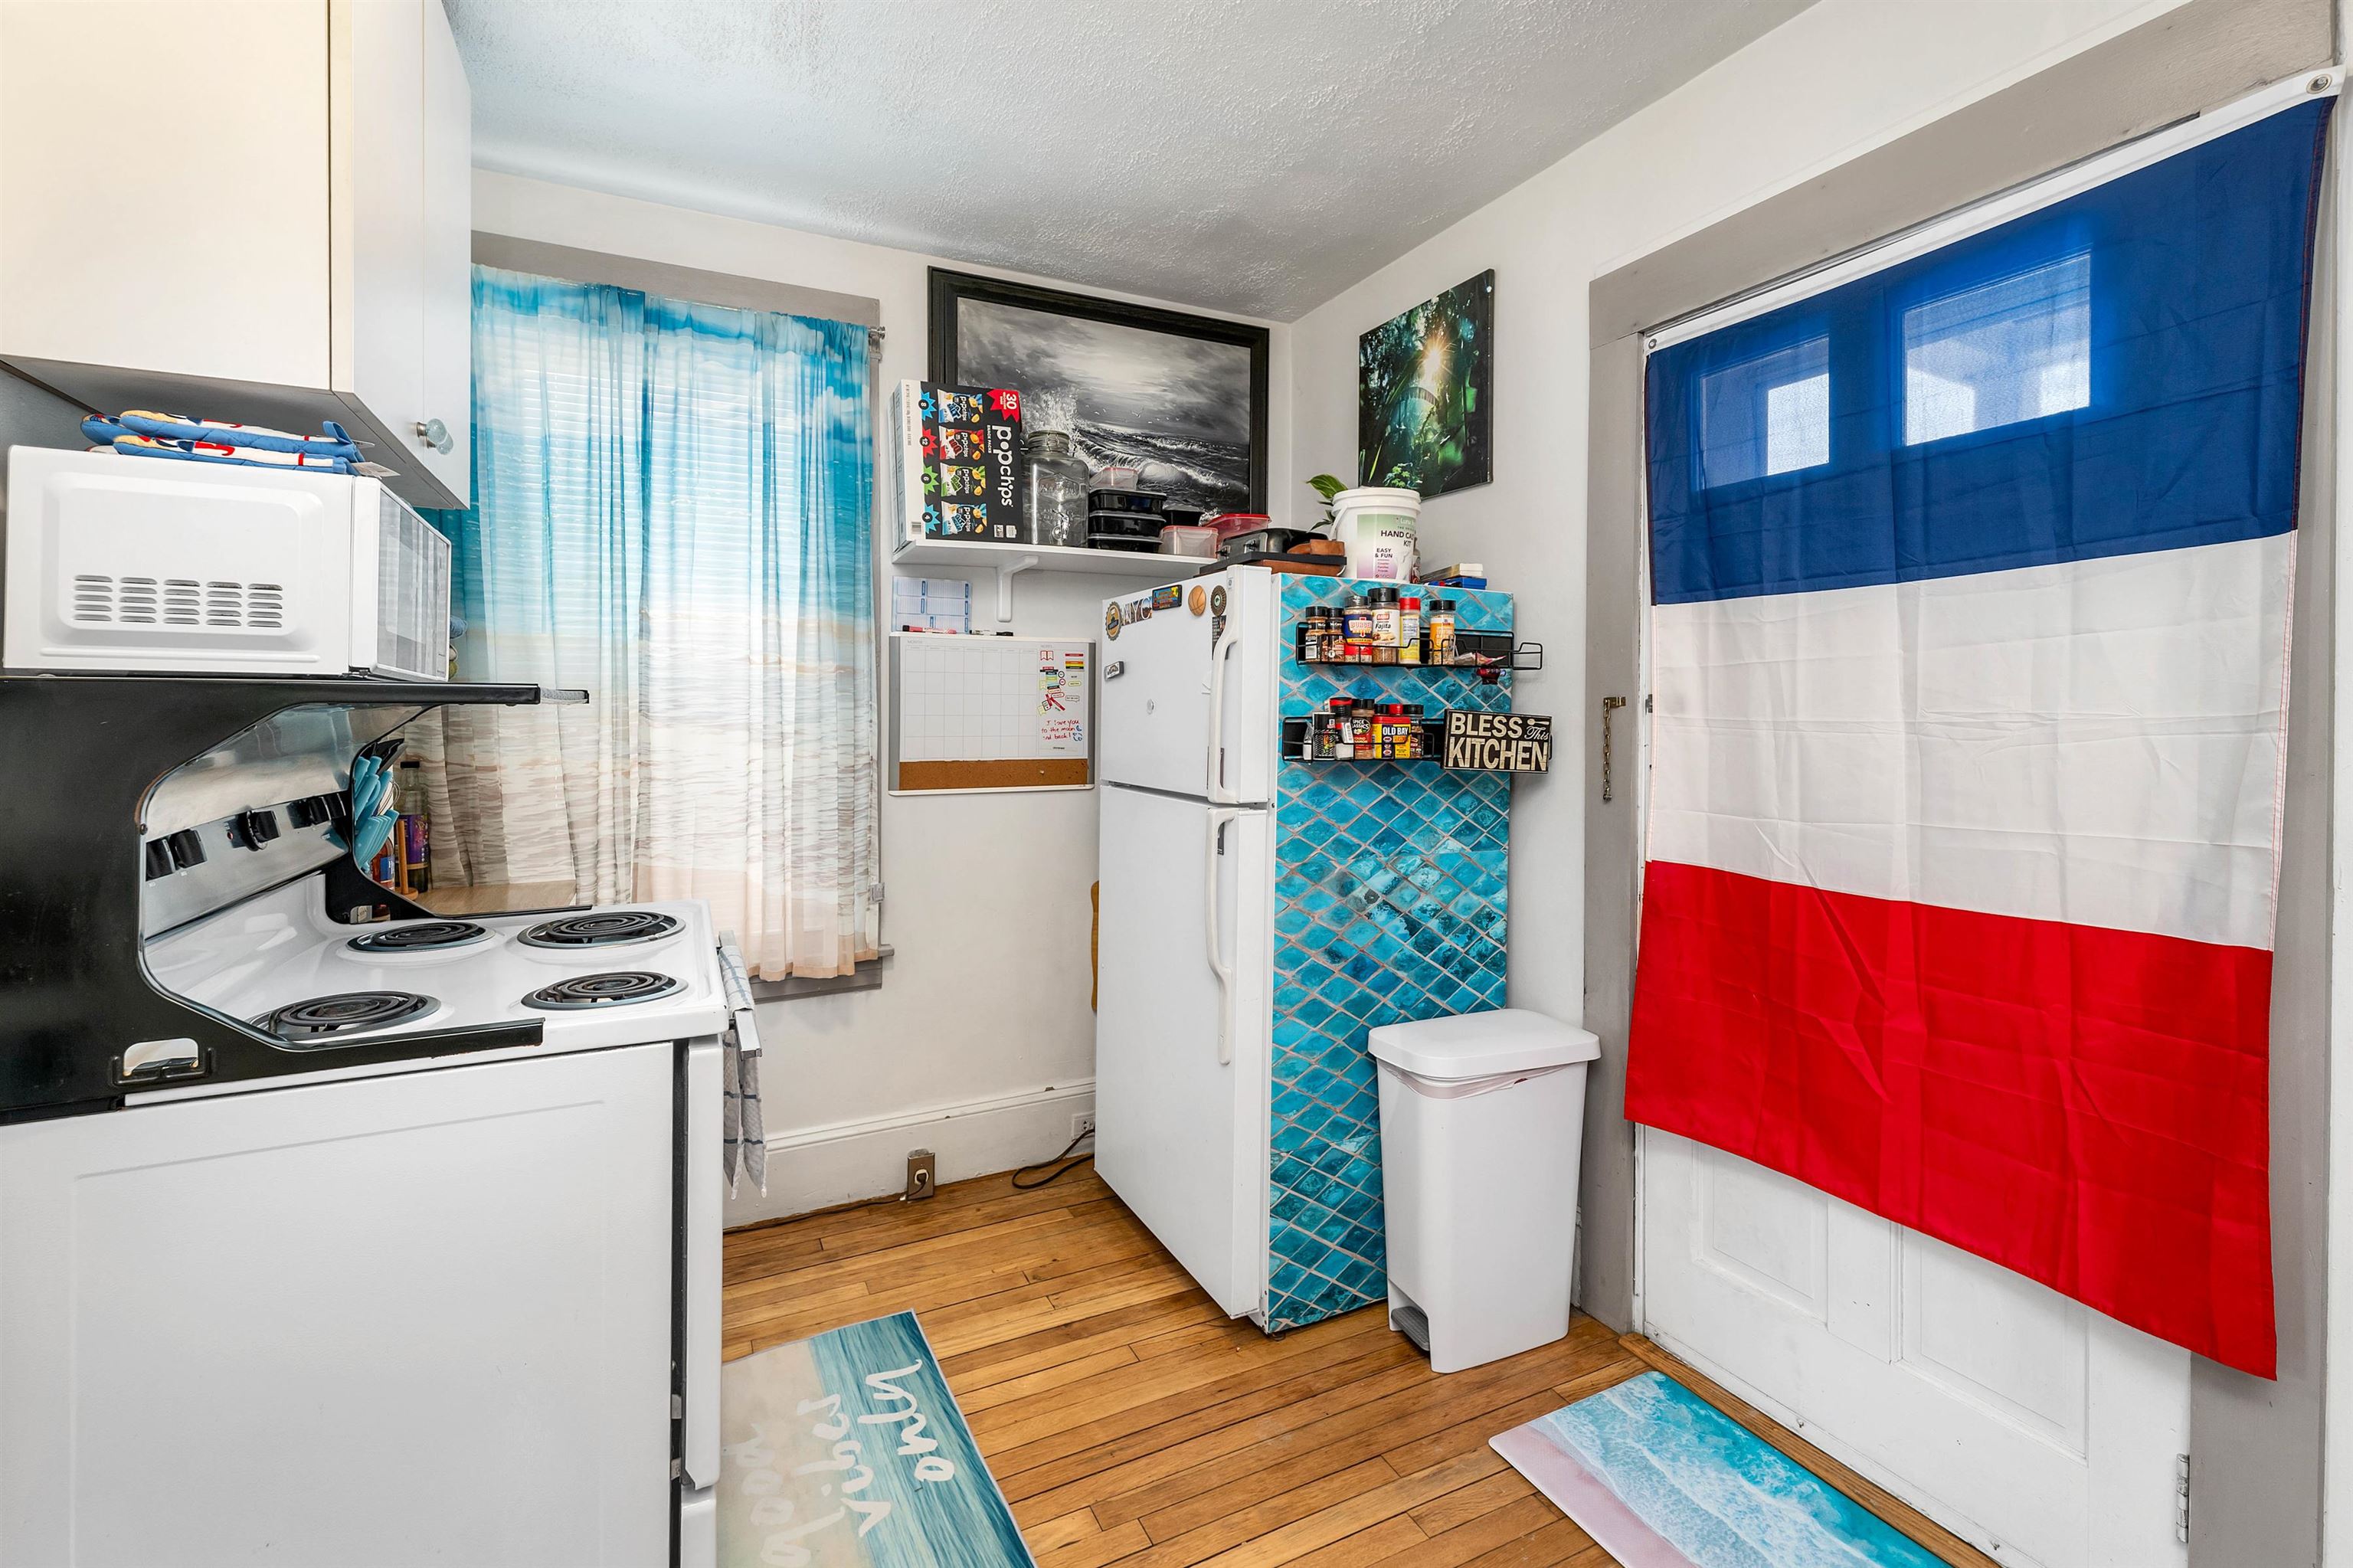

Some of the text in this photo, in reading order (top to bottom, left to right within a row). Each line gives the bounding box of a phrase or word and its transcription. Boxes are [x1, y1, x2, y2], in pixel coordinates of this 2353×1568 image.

[960, 396, 968, 421] popchips
[1006, 393, 1017, 410] 30
[961, 432, 969, 457] popchips
[992, 425, 1015, 506] popchips
[1121, 597, 1152, 626] NYC
[1067, 719, 1080, 728] you
[1383, 726, 1409, 735] OLD BAY
[1450, 712, 1549, 740] BLESS This
[1448, 736, 1548, 771] KITCHEN
[858, 1359, 954, 1482] only
[797, 1394, 891, 1537] vibes
[723, 1422, 845, 1567] good
